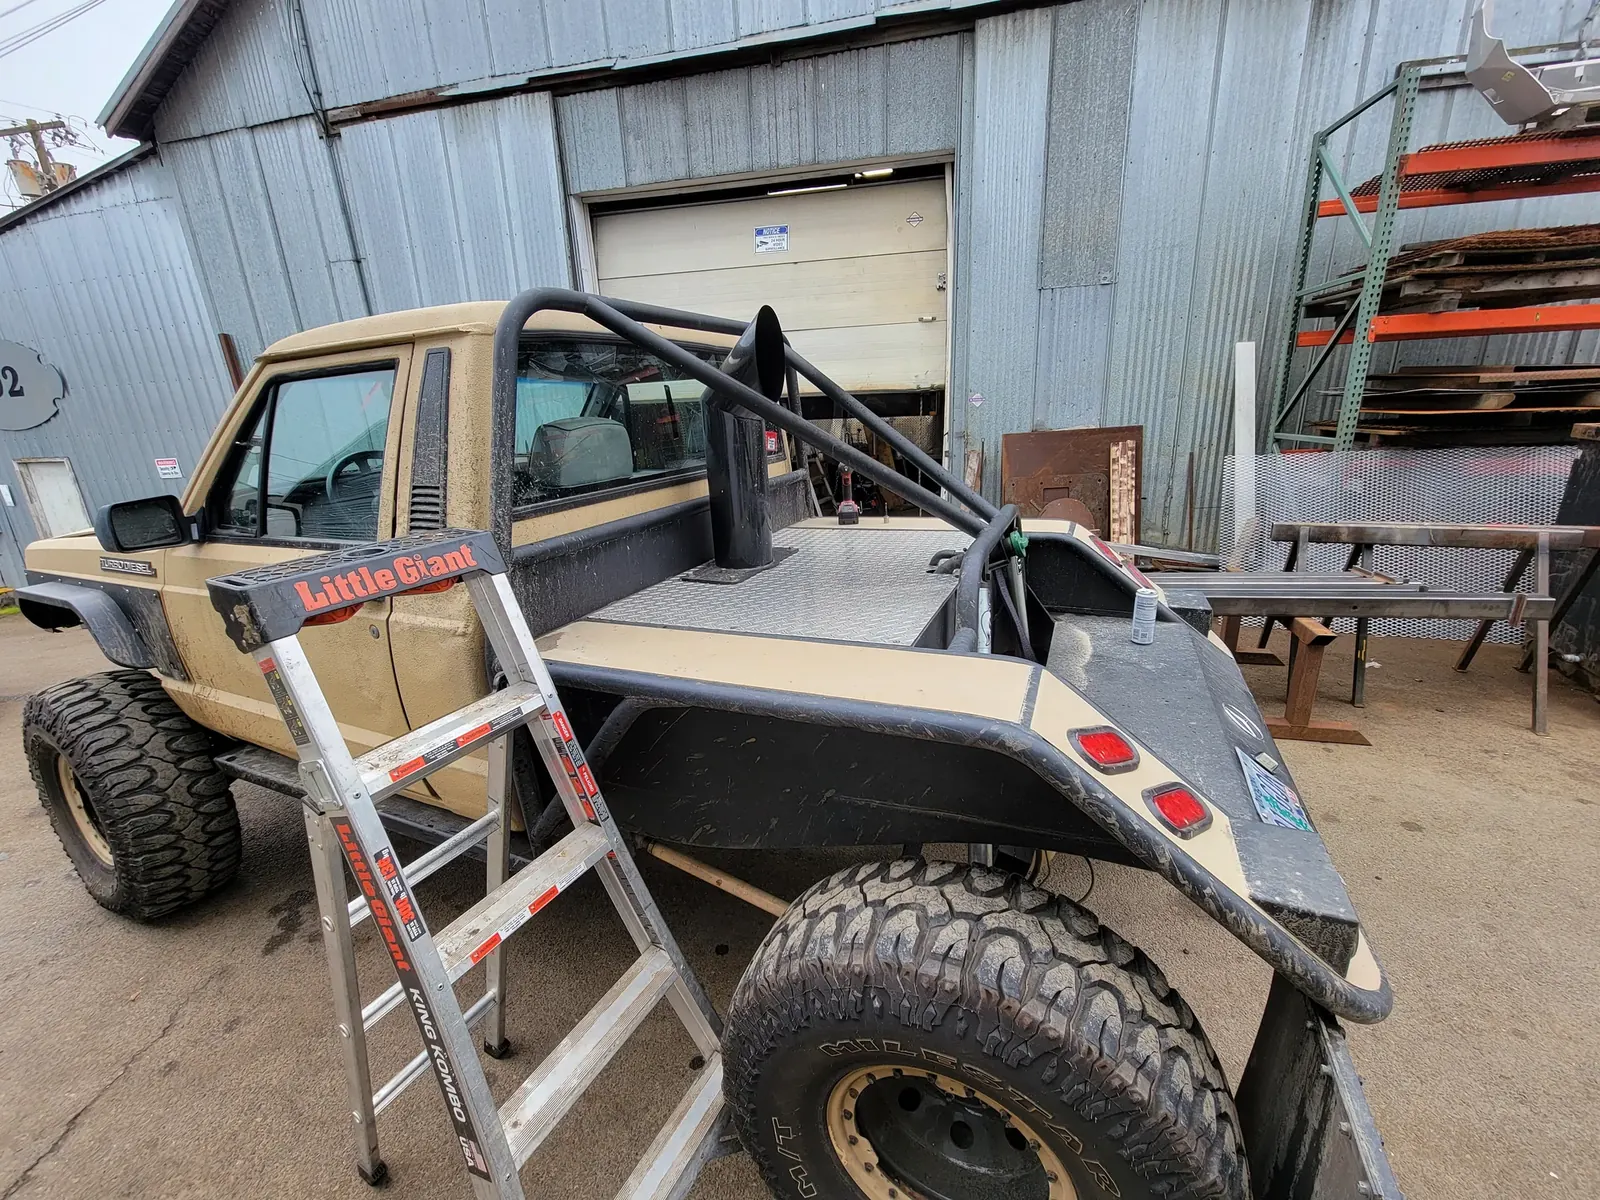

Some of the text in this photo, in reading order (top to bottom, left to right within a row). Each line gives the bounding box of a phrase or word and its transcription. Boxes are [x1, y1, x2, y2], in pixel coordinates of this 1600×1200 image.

[762, 227, 780, 235] NOTICE
[0, 365, 25, 398] 2
[294, 543, 477, 612] Little Giant
[558, 718, 570, 738] DANGER
[583, 771, 595, 792] PELIGRO
[335, 823, 411, 972] Little Giant
[409, 987, 467, 1124] KING KOMBO
[818, 1038, 1122, 1198] MILESTAR
[459, 1136, 475, 1168] USA
[771, 1116, 818, 1199] M/T
